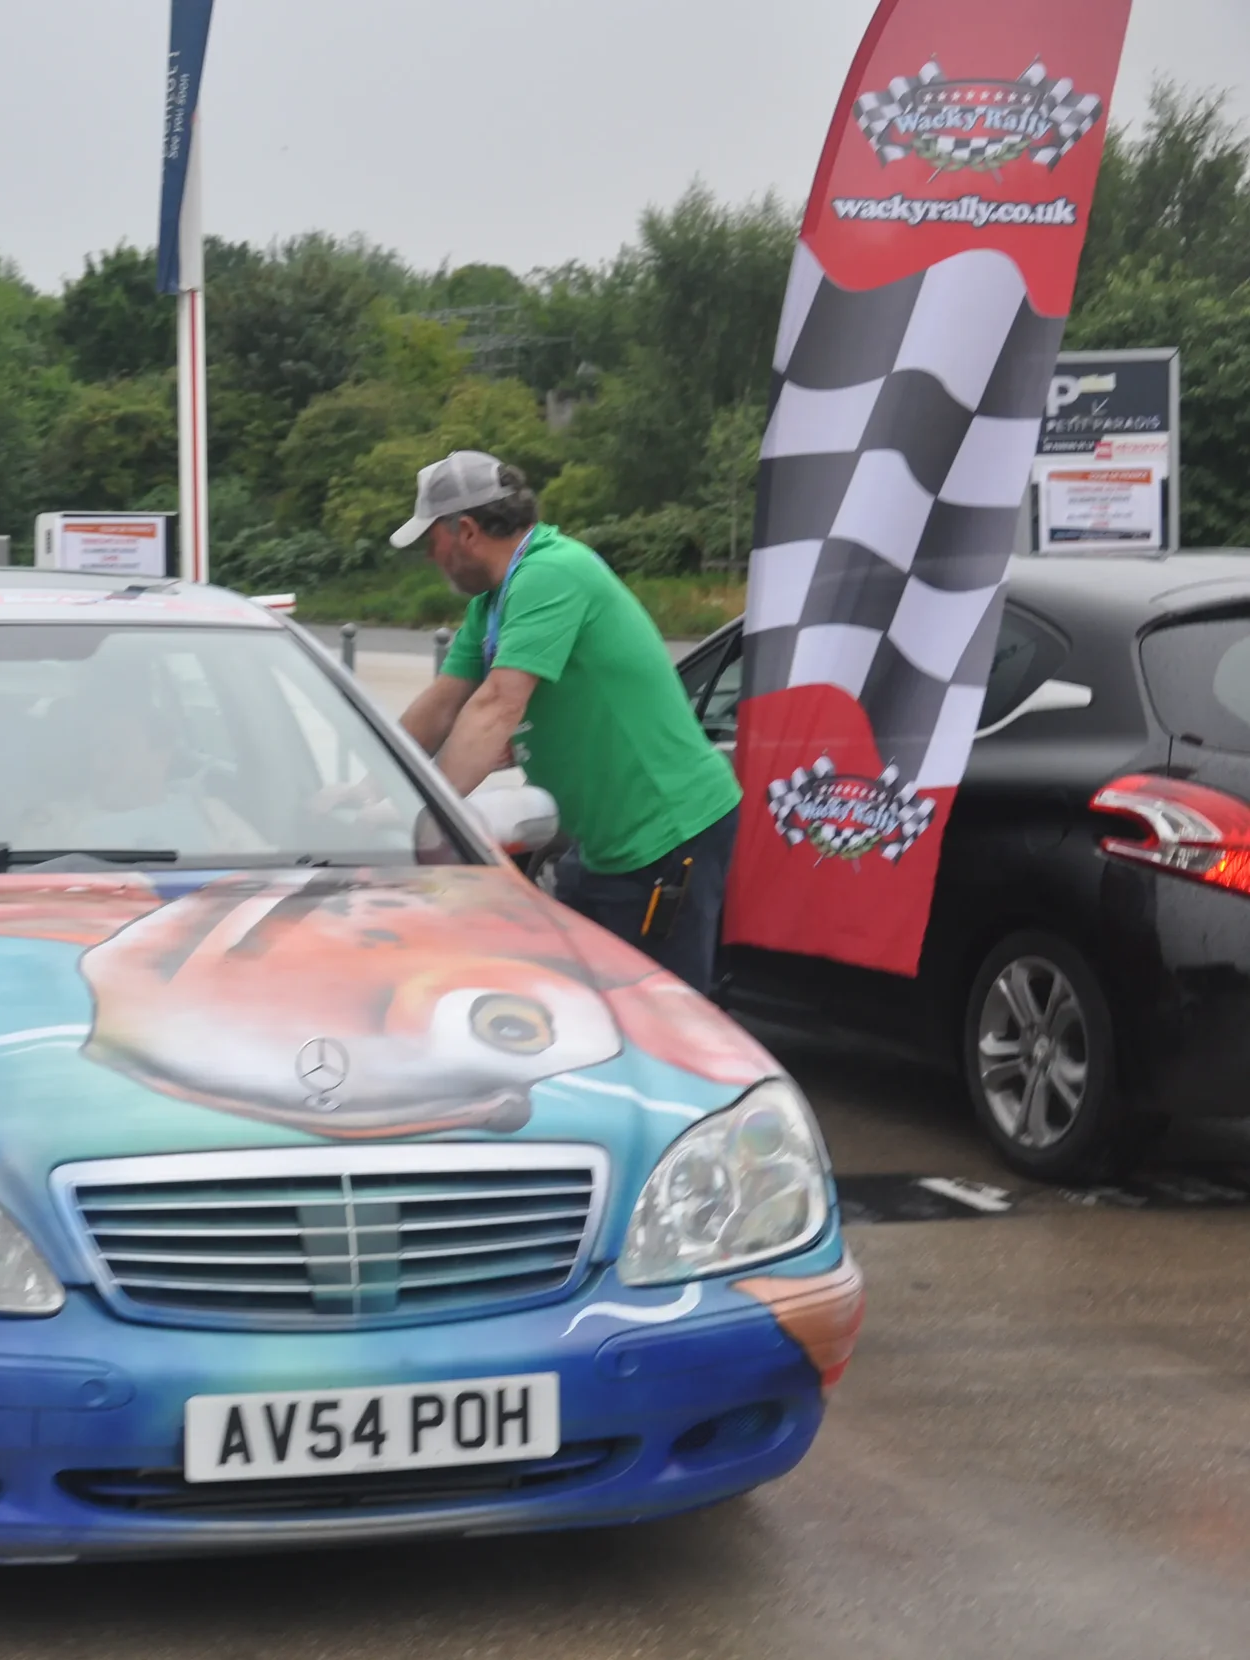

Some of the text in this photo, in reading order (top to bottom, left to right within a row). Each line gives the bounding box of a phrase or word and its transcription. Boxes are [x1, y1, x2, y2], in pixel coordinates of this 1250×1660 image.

[894, 106, 1053, 140] Wacky Rally
[832, 193, 1076, 228] wackyrally.co.uk
[216, 1385, 531, 1467] AV54 POH
